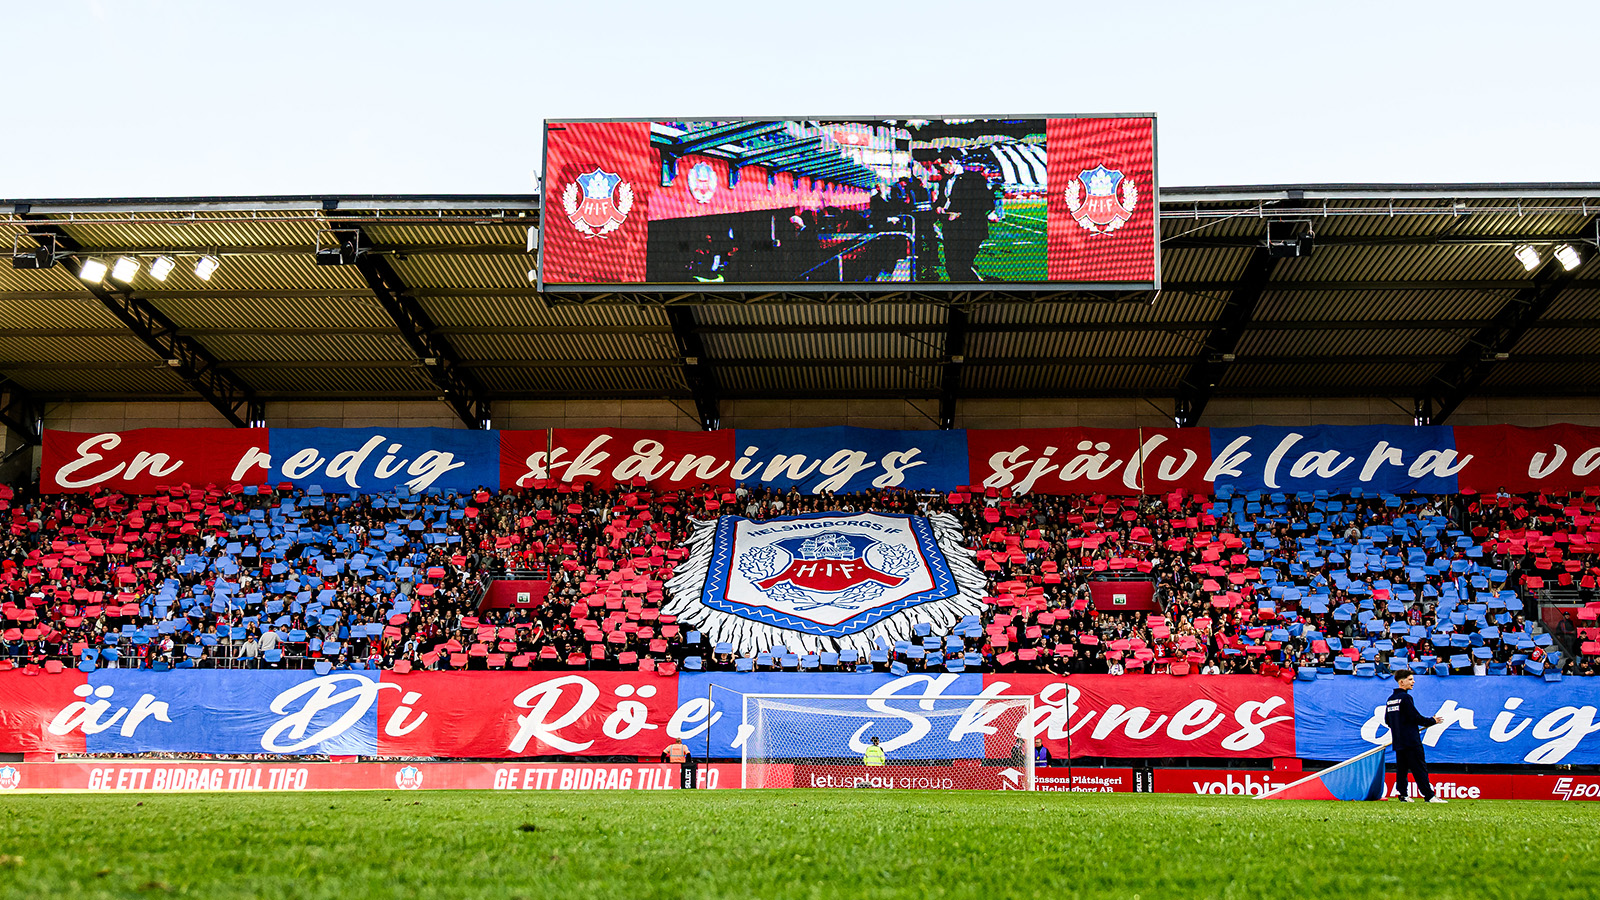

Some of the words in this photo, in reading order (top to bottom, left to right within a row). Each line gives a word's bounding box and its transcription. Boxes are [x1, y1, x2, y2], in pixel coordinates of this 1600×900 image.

[55, 433, 184, 489] En
[230, 435, 466, 495] redig
[516, 434, 927, 494] skånings
[982, 432, 1474, 496] självklara
[747, 520, 883, 538] HELSINGBORGS
[885, 527, 903, 535] IF
[48, 684, 172, 737] är
[261, 673, 427, 753] Di
[848, 673, 1294, 754] Skånes
[88, 768, 114, 790] GE
[117, 768, 151, 790] ETT
[152, 768, 224, 790] BIDRAG
[228, 768, 263, 790] TILL
[268, 768, 308, 790] TIFO
[493, 768, 519, 789] GE
[522, 768, 556, 789] ETT
[559, 768, 633, 789] BIDRAG
[637, 768, 674, 789] TILL
[811, 772, 894, 789] letusplay
[900, 775, 953, 789] group
[1072, 776, 1122, 786] Plåtslageri
[1573, 783, 1600, 797] BO
